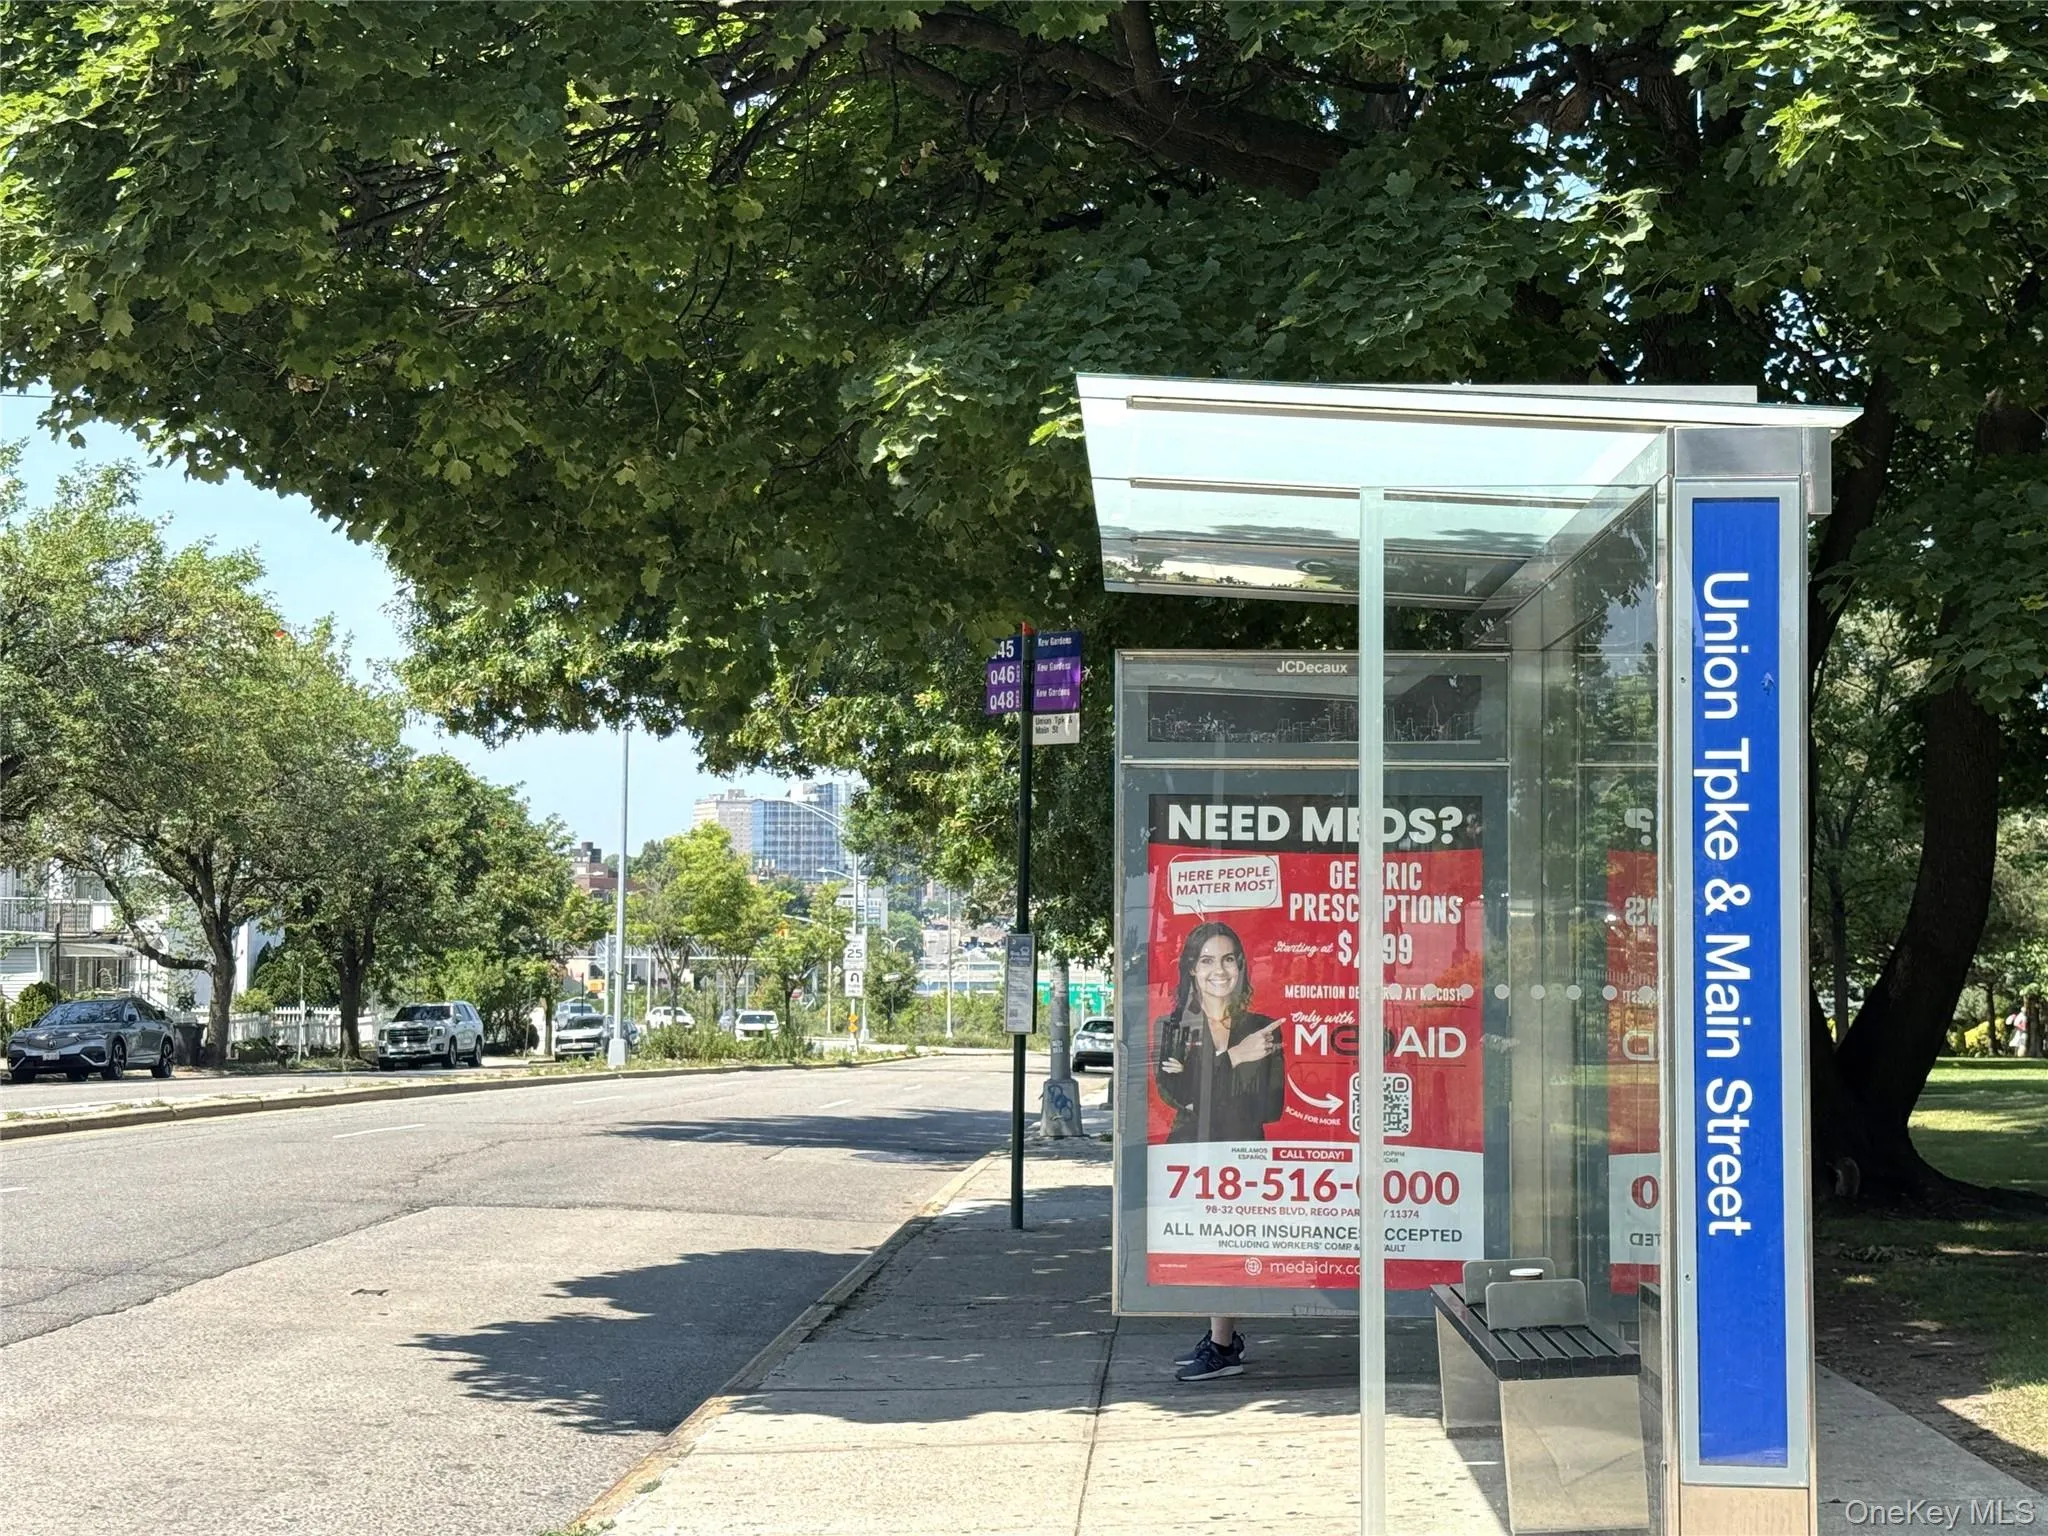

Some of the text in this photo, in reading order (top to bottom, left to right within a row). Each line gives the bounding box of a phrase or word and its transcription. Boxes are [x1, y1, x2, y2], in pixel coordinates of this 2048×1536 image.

[991, 640, 1014, 659] 45
[1038, 637, 1072, 647] Kew Gardens
[990, 665, 1015, 685] Q46
[1276, 660, 1348, 673] JCDecaux
[990, 690, 1014, 710] Q48
[1048, 688, 1070, 697] Gardens
[1168, 804, 1290, 842] NEED
[1178, 866, 1271, 882] HERE PEOPLE
[1329, 860, 1422, 891] GERIC
[1176, 879, 1275, 897] MATTER MOST
[1289, 893, 1462, 924] PRESCPTIONS
[1693, 572, 1752, 1237] Union Tpke & Main Street
[847, 949, 863, 958] 25
[1273, 940, 1334, 958] Starting at
[1284, 984, 1345, 999] MEDICATION
[1404, 987, 1418, 1001] AT
[1290, 1009, 1356, 1029] Only with
[1285, 1105, 1342, 1126] SCAN FOR MORE
[1279, 1149, 1345, 1160] CALL TODAY!
[1166, 1165, 1460, 1206] 718-516-000
[1205, 1205, 1233, 1214] 98-32
[1235, 1205, 1277, 1216] QUEENS
[1279, 1207, 1308, 1217] BLVD,
[1310, 1208, 1339, 1217] REGO
[1340, 1208, 1360, 1217] PAR
[1390, 1210, 1420, 1219] 11374
[1163, 1222, 1462, 1242] ALL MAJOR INSURANCE CCEPTED
[1218, 1240, 1269, 1249] INCLUDING
[1272, 1241, 1322, 1250] WORKERS'
[1270, 1261, 1360, 1275] medaidrx.co
